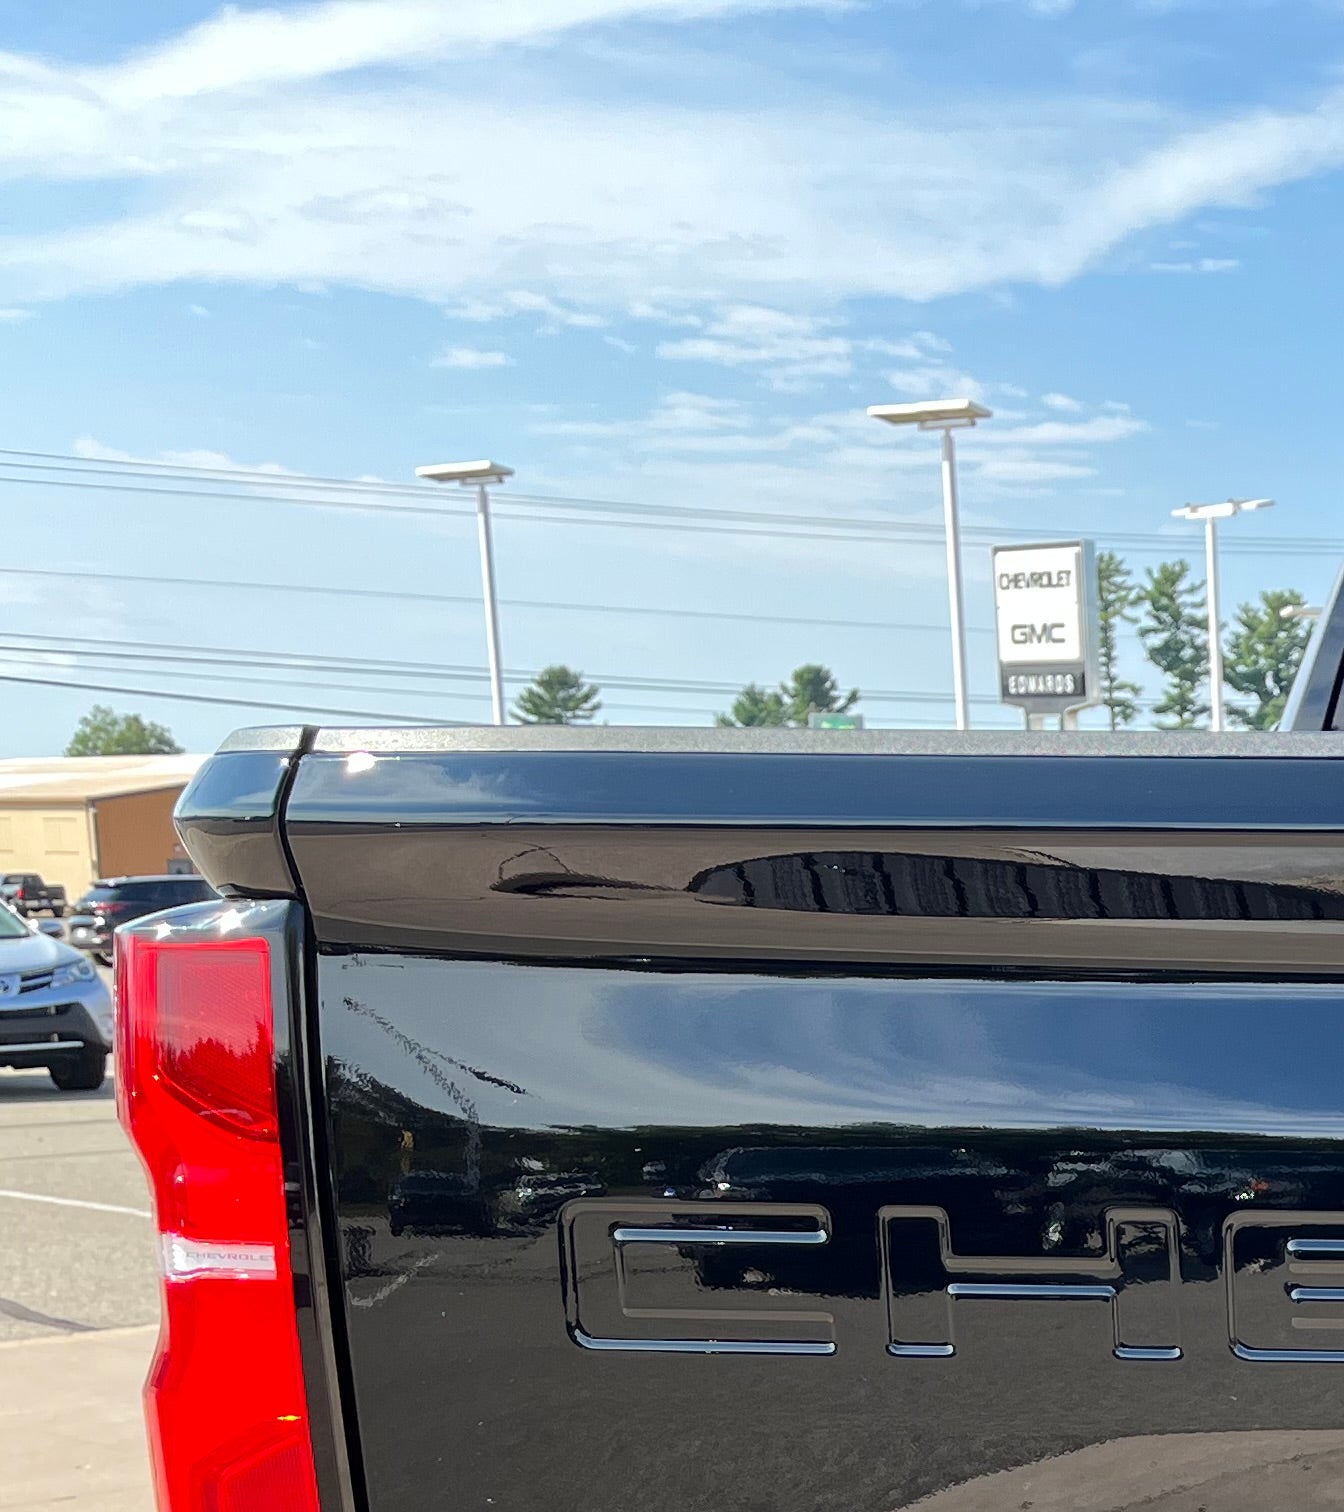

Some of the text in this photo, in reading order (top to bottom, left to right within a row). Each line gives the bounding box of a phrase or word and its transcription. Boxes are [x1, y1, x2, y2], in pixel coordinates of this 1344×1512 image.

[999, 570, 1071, 590] CHEVROLET
[1011, 623, 1065, 644] GMC
[1008, 674, 1074, 694] EDWARDS
